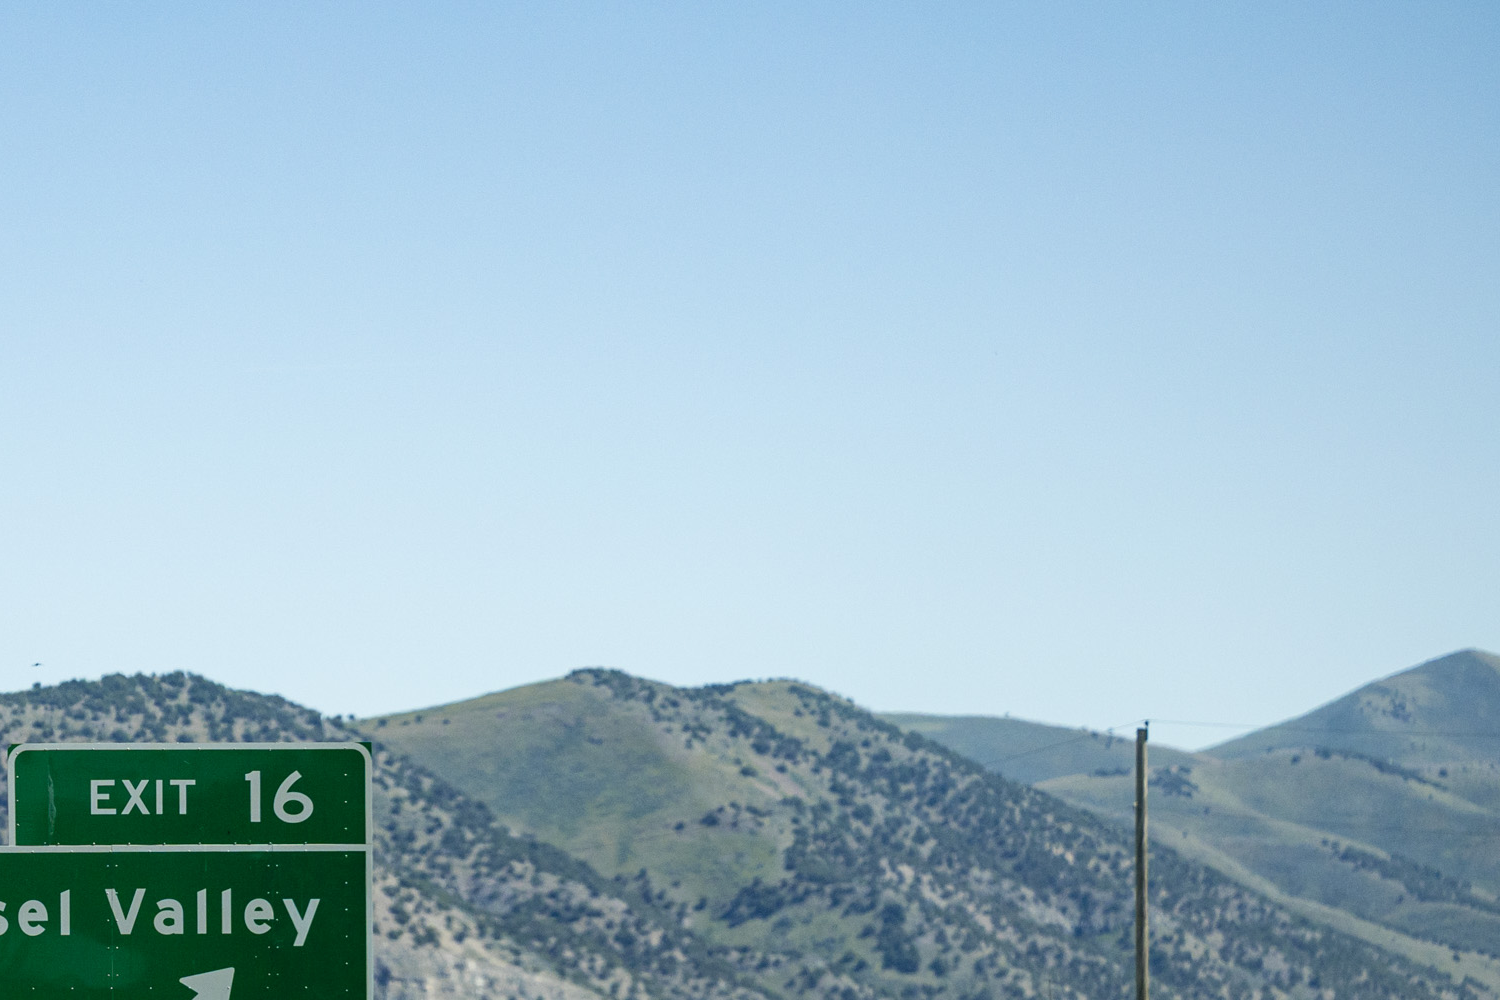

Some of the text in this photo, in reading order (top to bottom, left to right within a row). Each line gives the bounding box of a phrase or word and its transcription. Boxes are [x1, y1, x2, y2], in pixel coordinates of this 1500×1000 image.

[90, 770, 314, 824] EXIT 16
[104, 887, 321, 947] Valley
